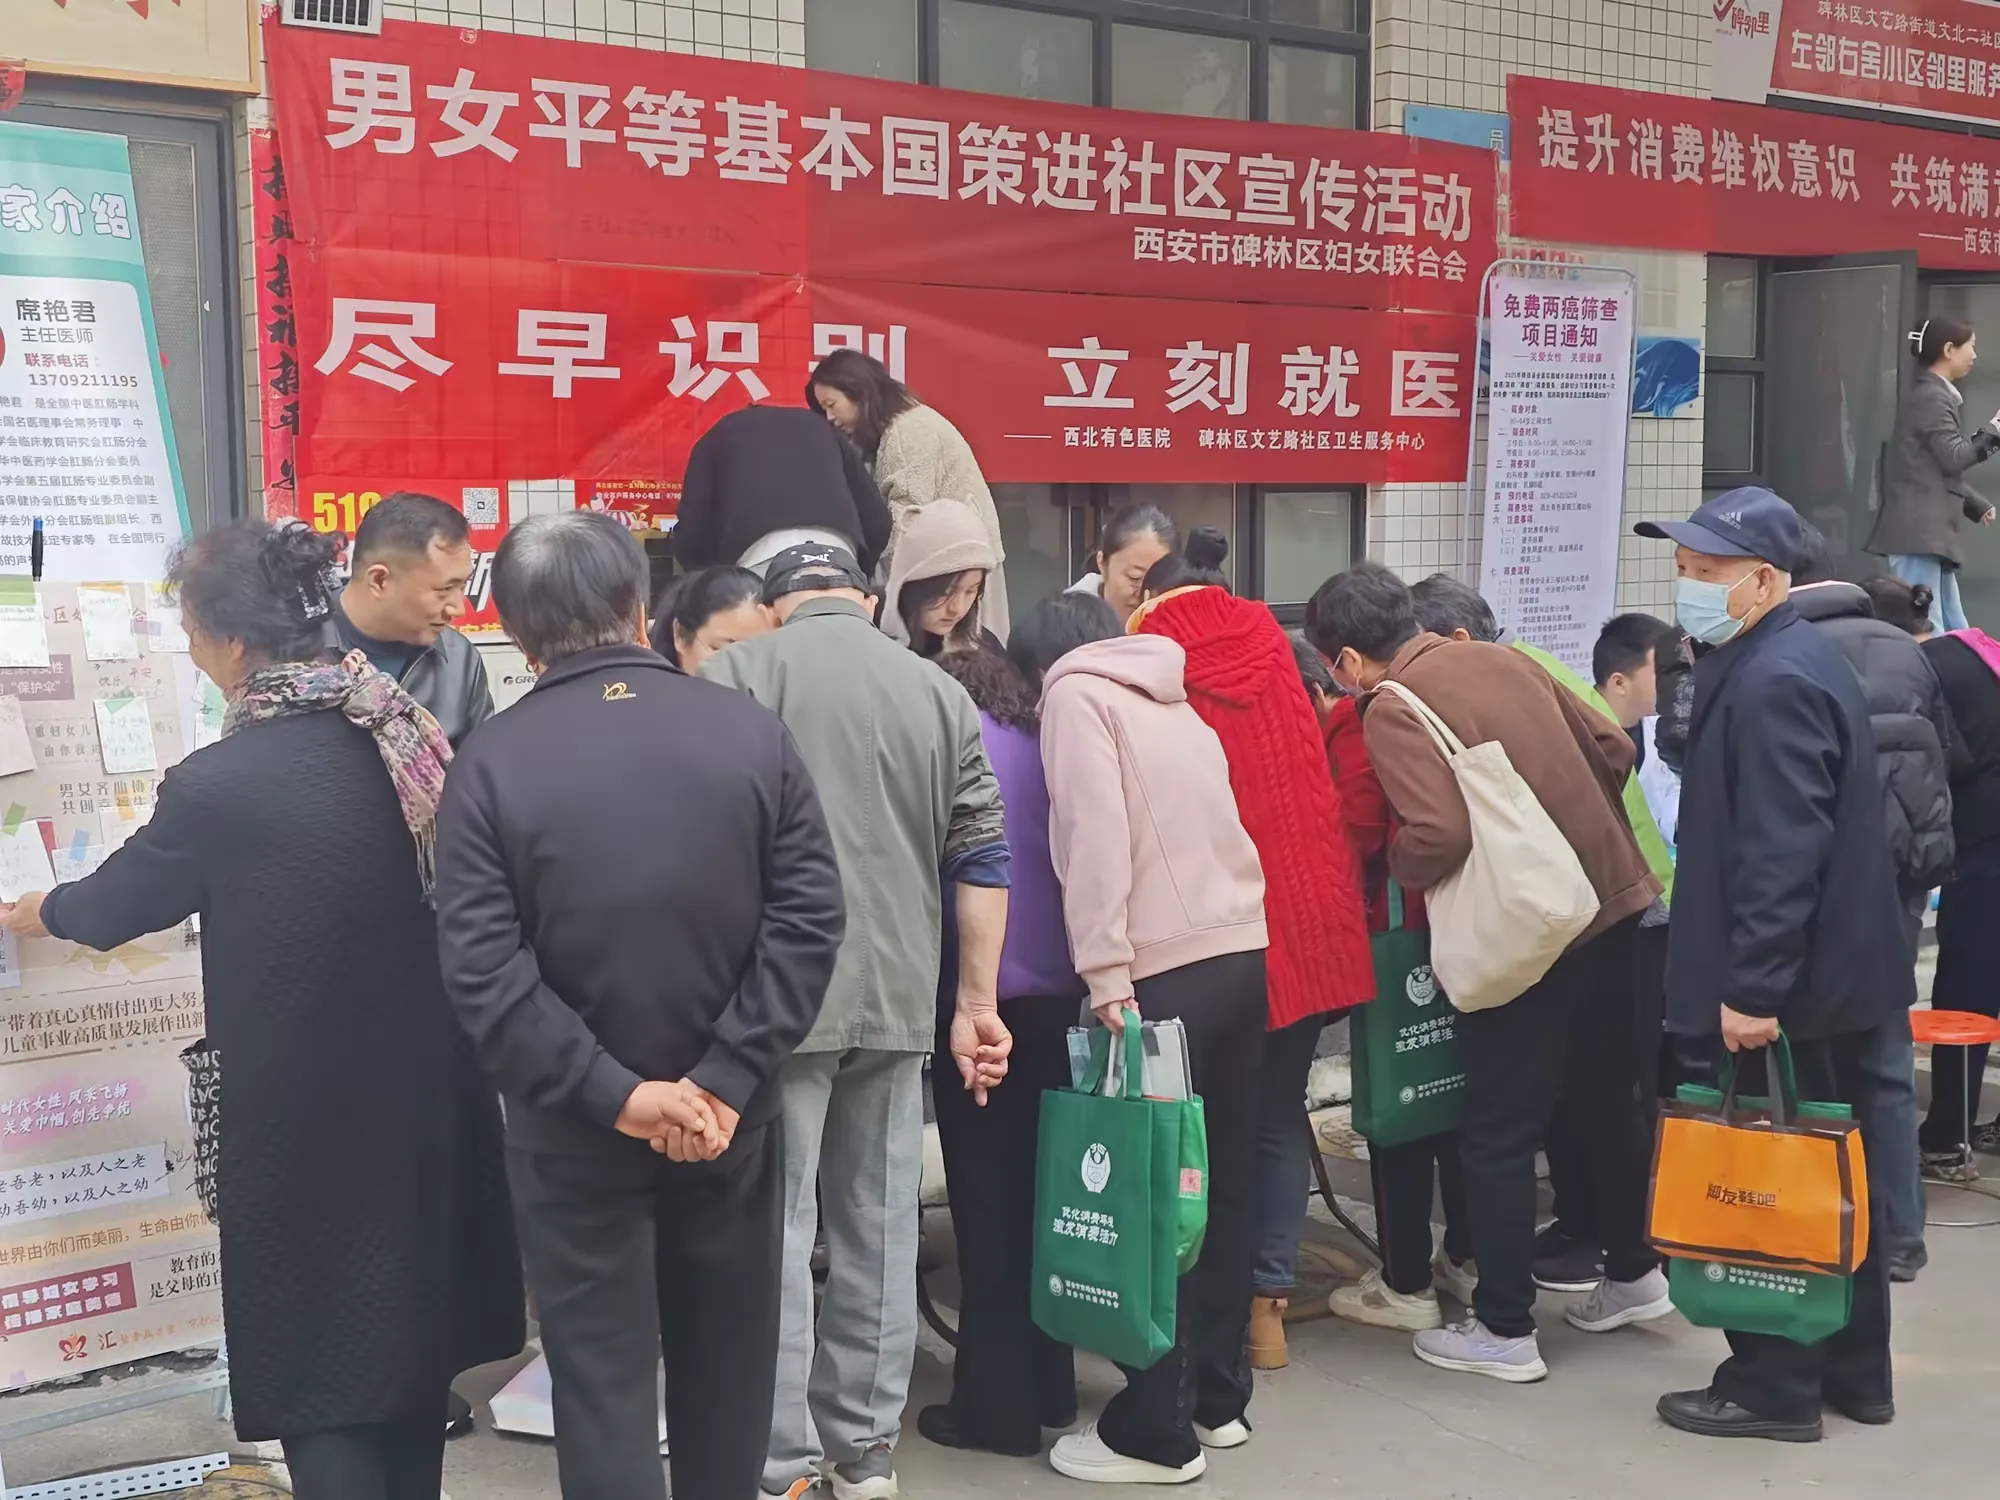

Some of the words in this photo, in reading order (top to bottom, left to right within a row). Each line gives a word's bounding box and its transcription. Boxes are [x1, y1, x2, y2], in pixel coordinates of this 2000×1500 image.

[325, 57, 1473, 242] 男女平等基本国策进社区宣传活动
[1538, 105, 1860, 202] 提升消费维权意识
[1890, 152, 2000, 219] 共筑满
[1, 184, 133, 240] 家介绍
[1133, 226, 1468, 283] 西安市碑林区妇女联合会
[16, 299, 96, 323] 席艳君
[1504, 294, 1618, 321] 免费两癌筛查
[20, 327, 94, 344] 主任医师
[1522, 324, 1598, 347] 项目通知
[29, 374, 138, 387] 13709211195
[1044, 337, 1461, 418] 立刻就医
[1199, 426, 1425, 451] 碑林区文艺路社区卫生服务中心
[0, 475, 155, 486] 学会第五届肛肠专业委员会副
[515, 675, 539, 685] GRE
[0, 991, 205, 1032] “带着真心真情付出更大努
[1395, 1027, 1457, 1053] 激发消费活
